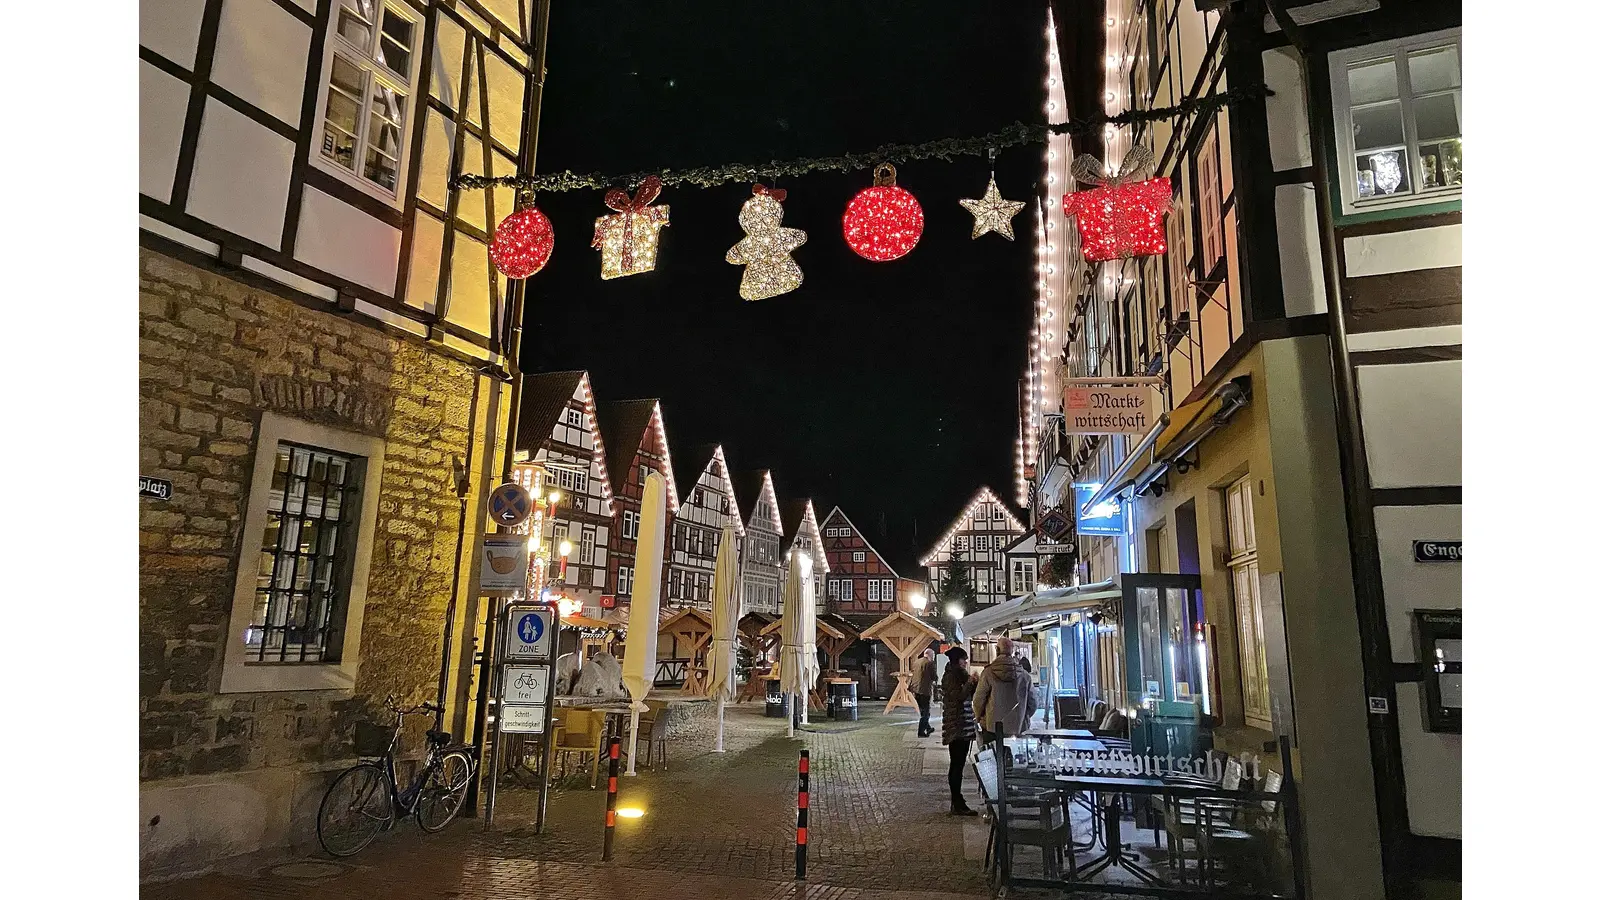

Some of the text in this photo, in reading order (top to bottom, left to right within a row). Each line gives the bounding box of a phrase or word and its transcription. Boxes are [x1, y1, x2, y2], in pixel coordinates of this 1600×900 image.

[1074, 412, 1146, 431] wirtschaft
[139, 480, 166, 497] platz
[518, 645, 540, 654] ZONE
[518, 690, 532, 699] frei
[504, 721, 541, 730] geschwindigkeit
